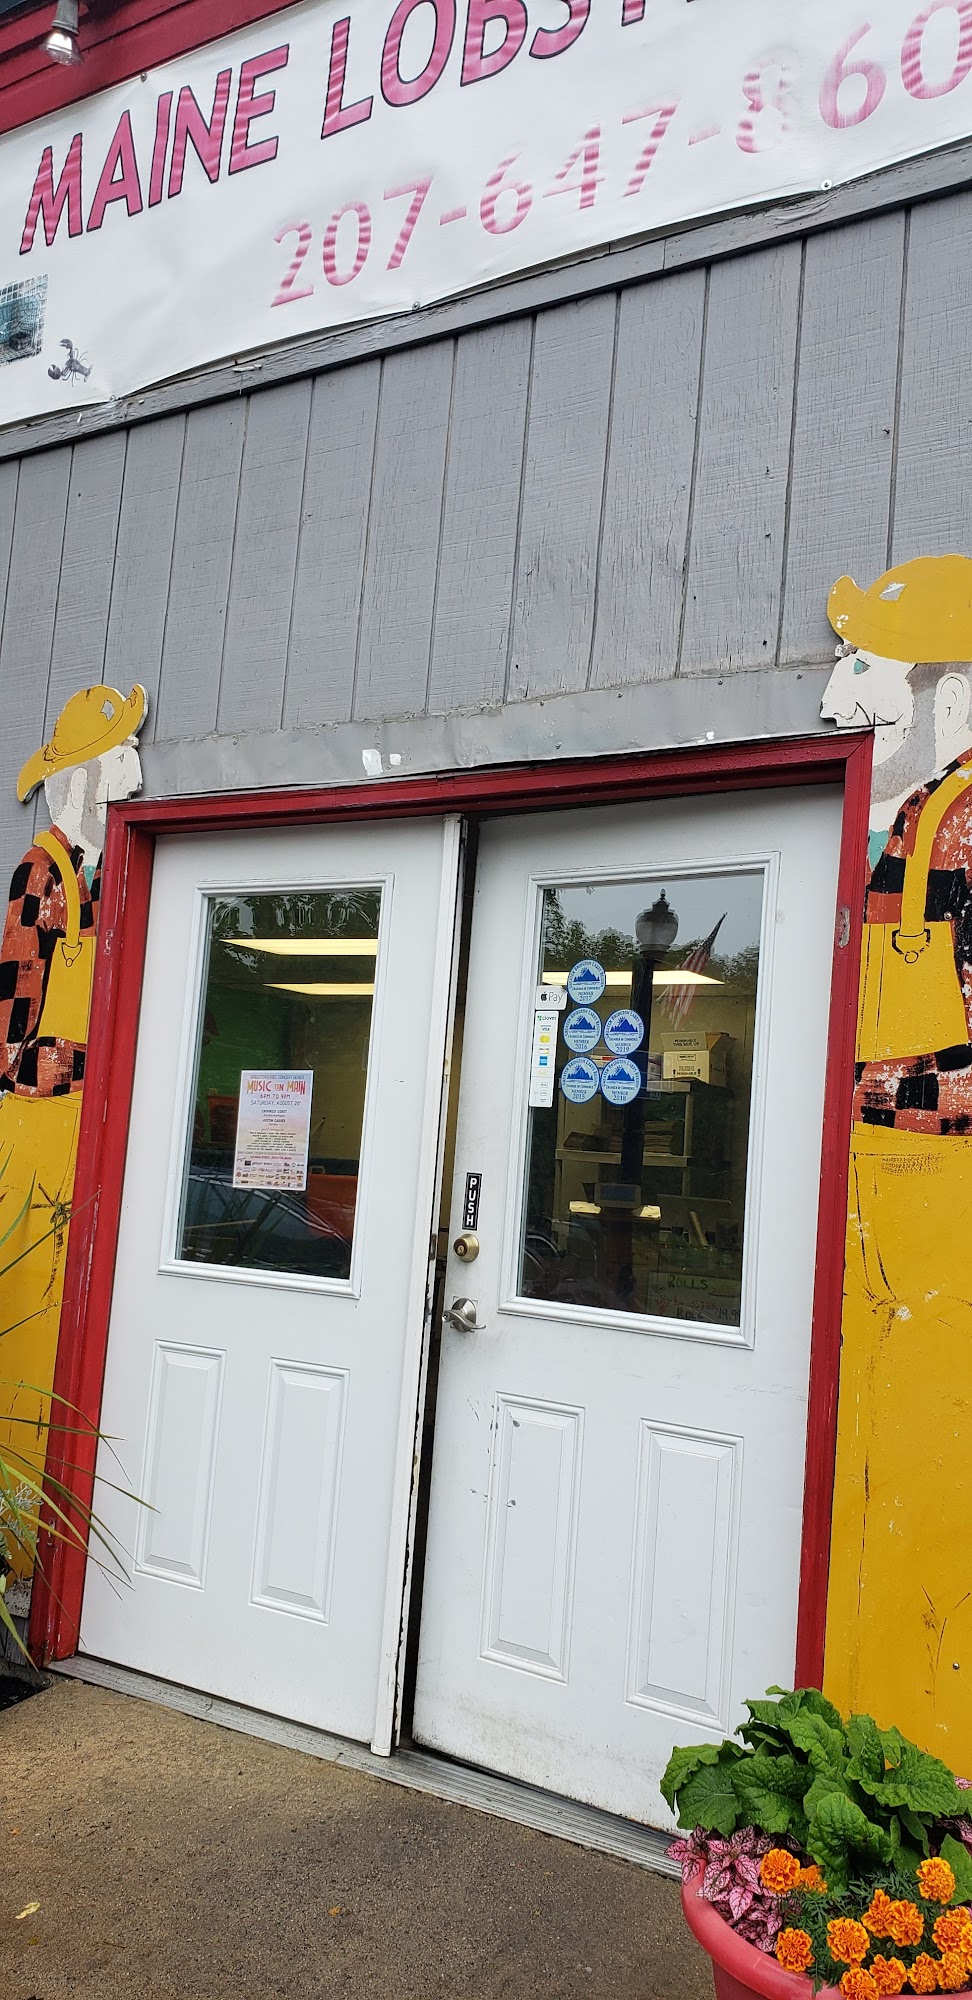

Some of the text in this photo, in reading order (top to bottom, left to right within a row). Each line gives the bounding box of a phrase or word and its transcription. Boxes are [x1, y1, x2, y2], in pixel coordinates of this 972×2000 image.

[19, 43, 290, 255] MAINE
[548, 992, 564, 1003] Pay
[247, 1080, 272, 1094] MUSIC
[287, 1080, 306, 1095] MAIN
[466, 1177, 477, 1226] PUSH
[718, 1307, 740, 1321] 19.9
